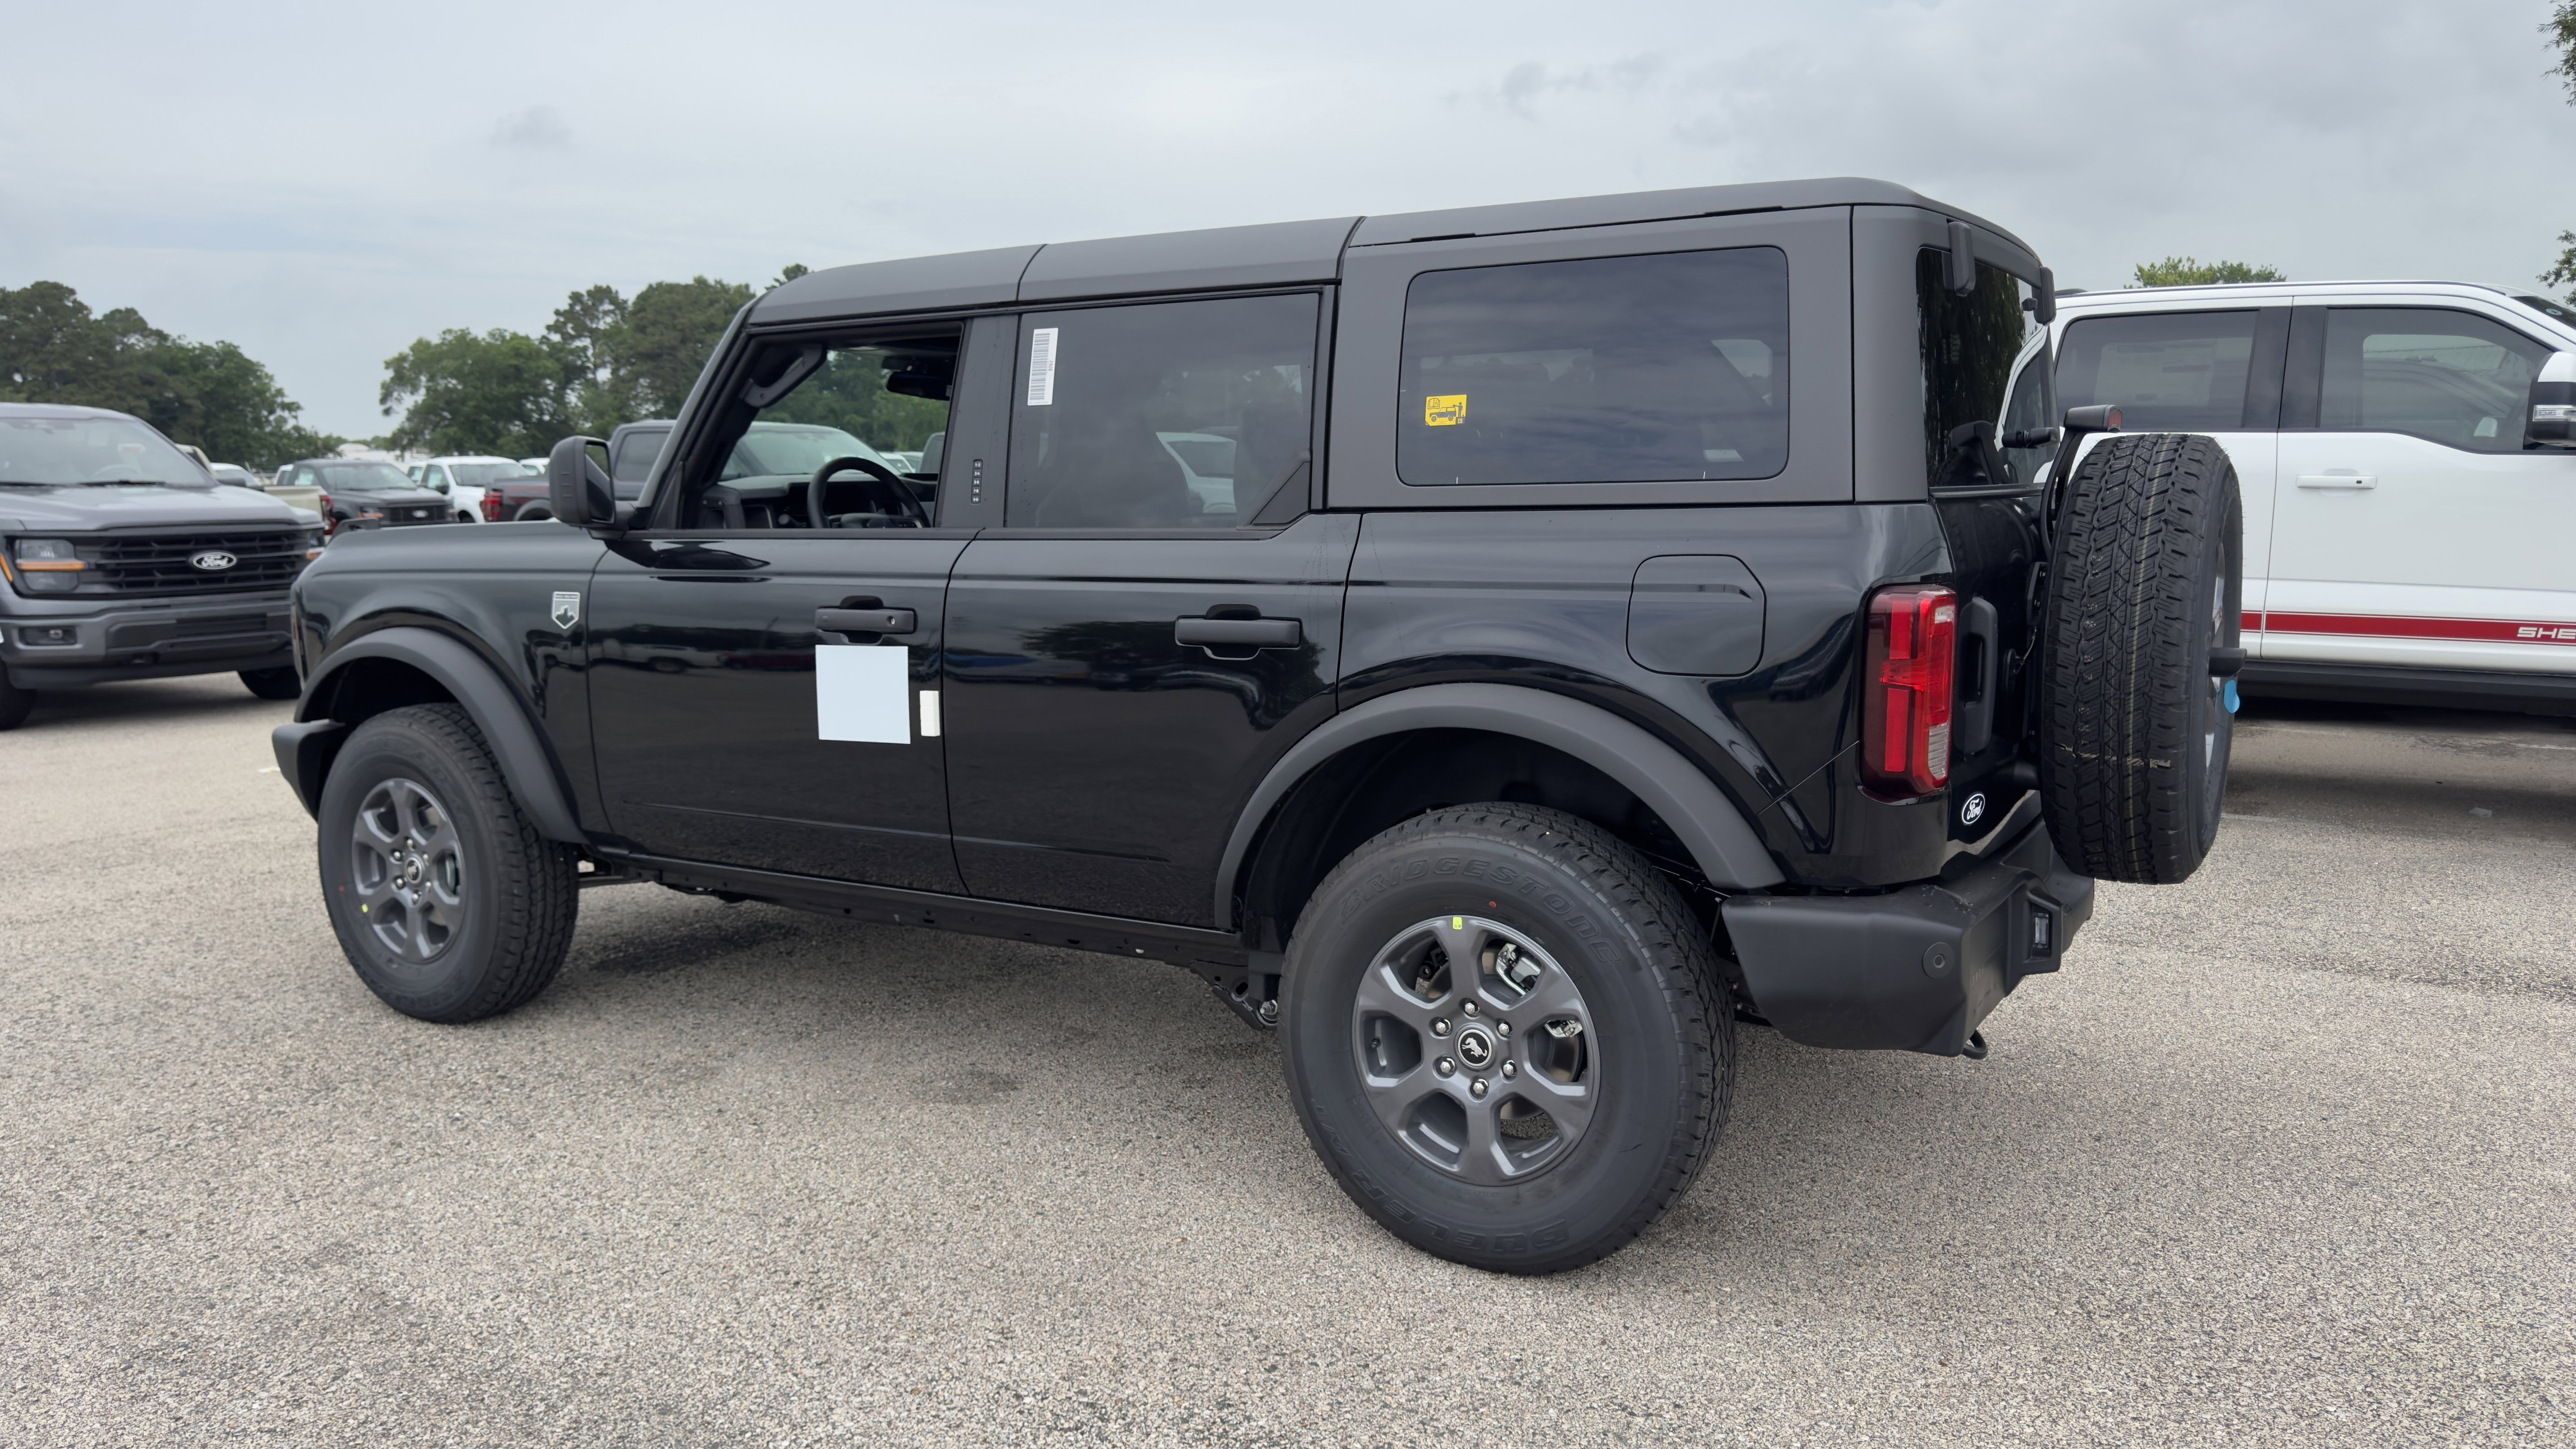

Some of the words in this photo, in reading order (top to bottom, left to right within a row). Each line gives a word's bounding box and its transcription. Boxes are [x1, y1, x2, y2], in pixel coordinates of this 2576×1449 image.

[2517, 627, 2576, 639] SHE
[1966, 798, 1983, 820] Ford
[1341, 856, 1622, 964] BRIDGESTONE
[1353, 1169, 1570, 1254] DUELER
